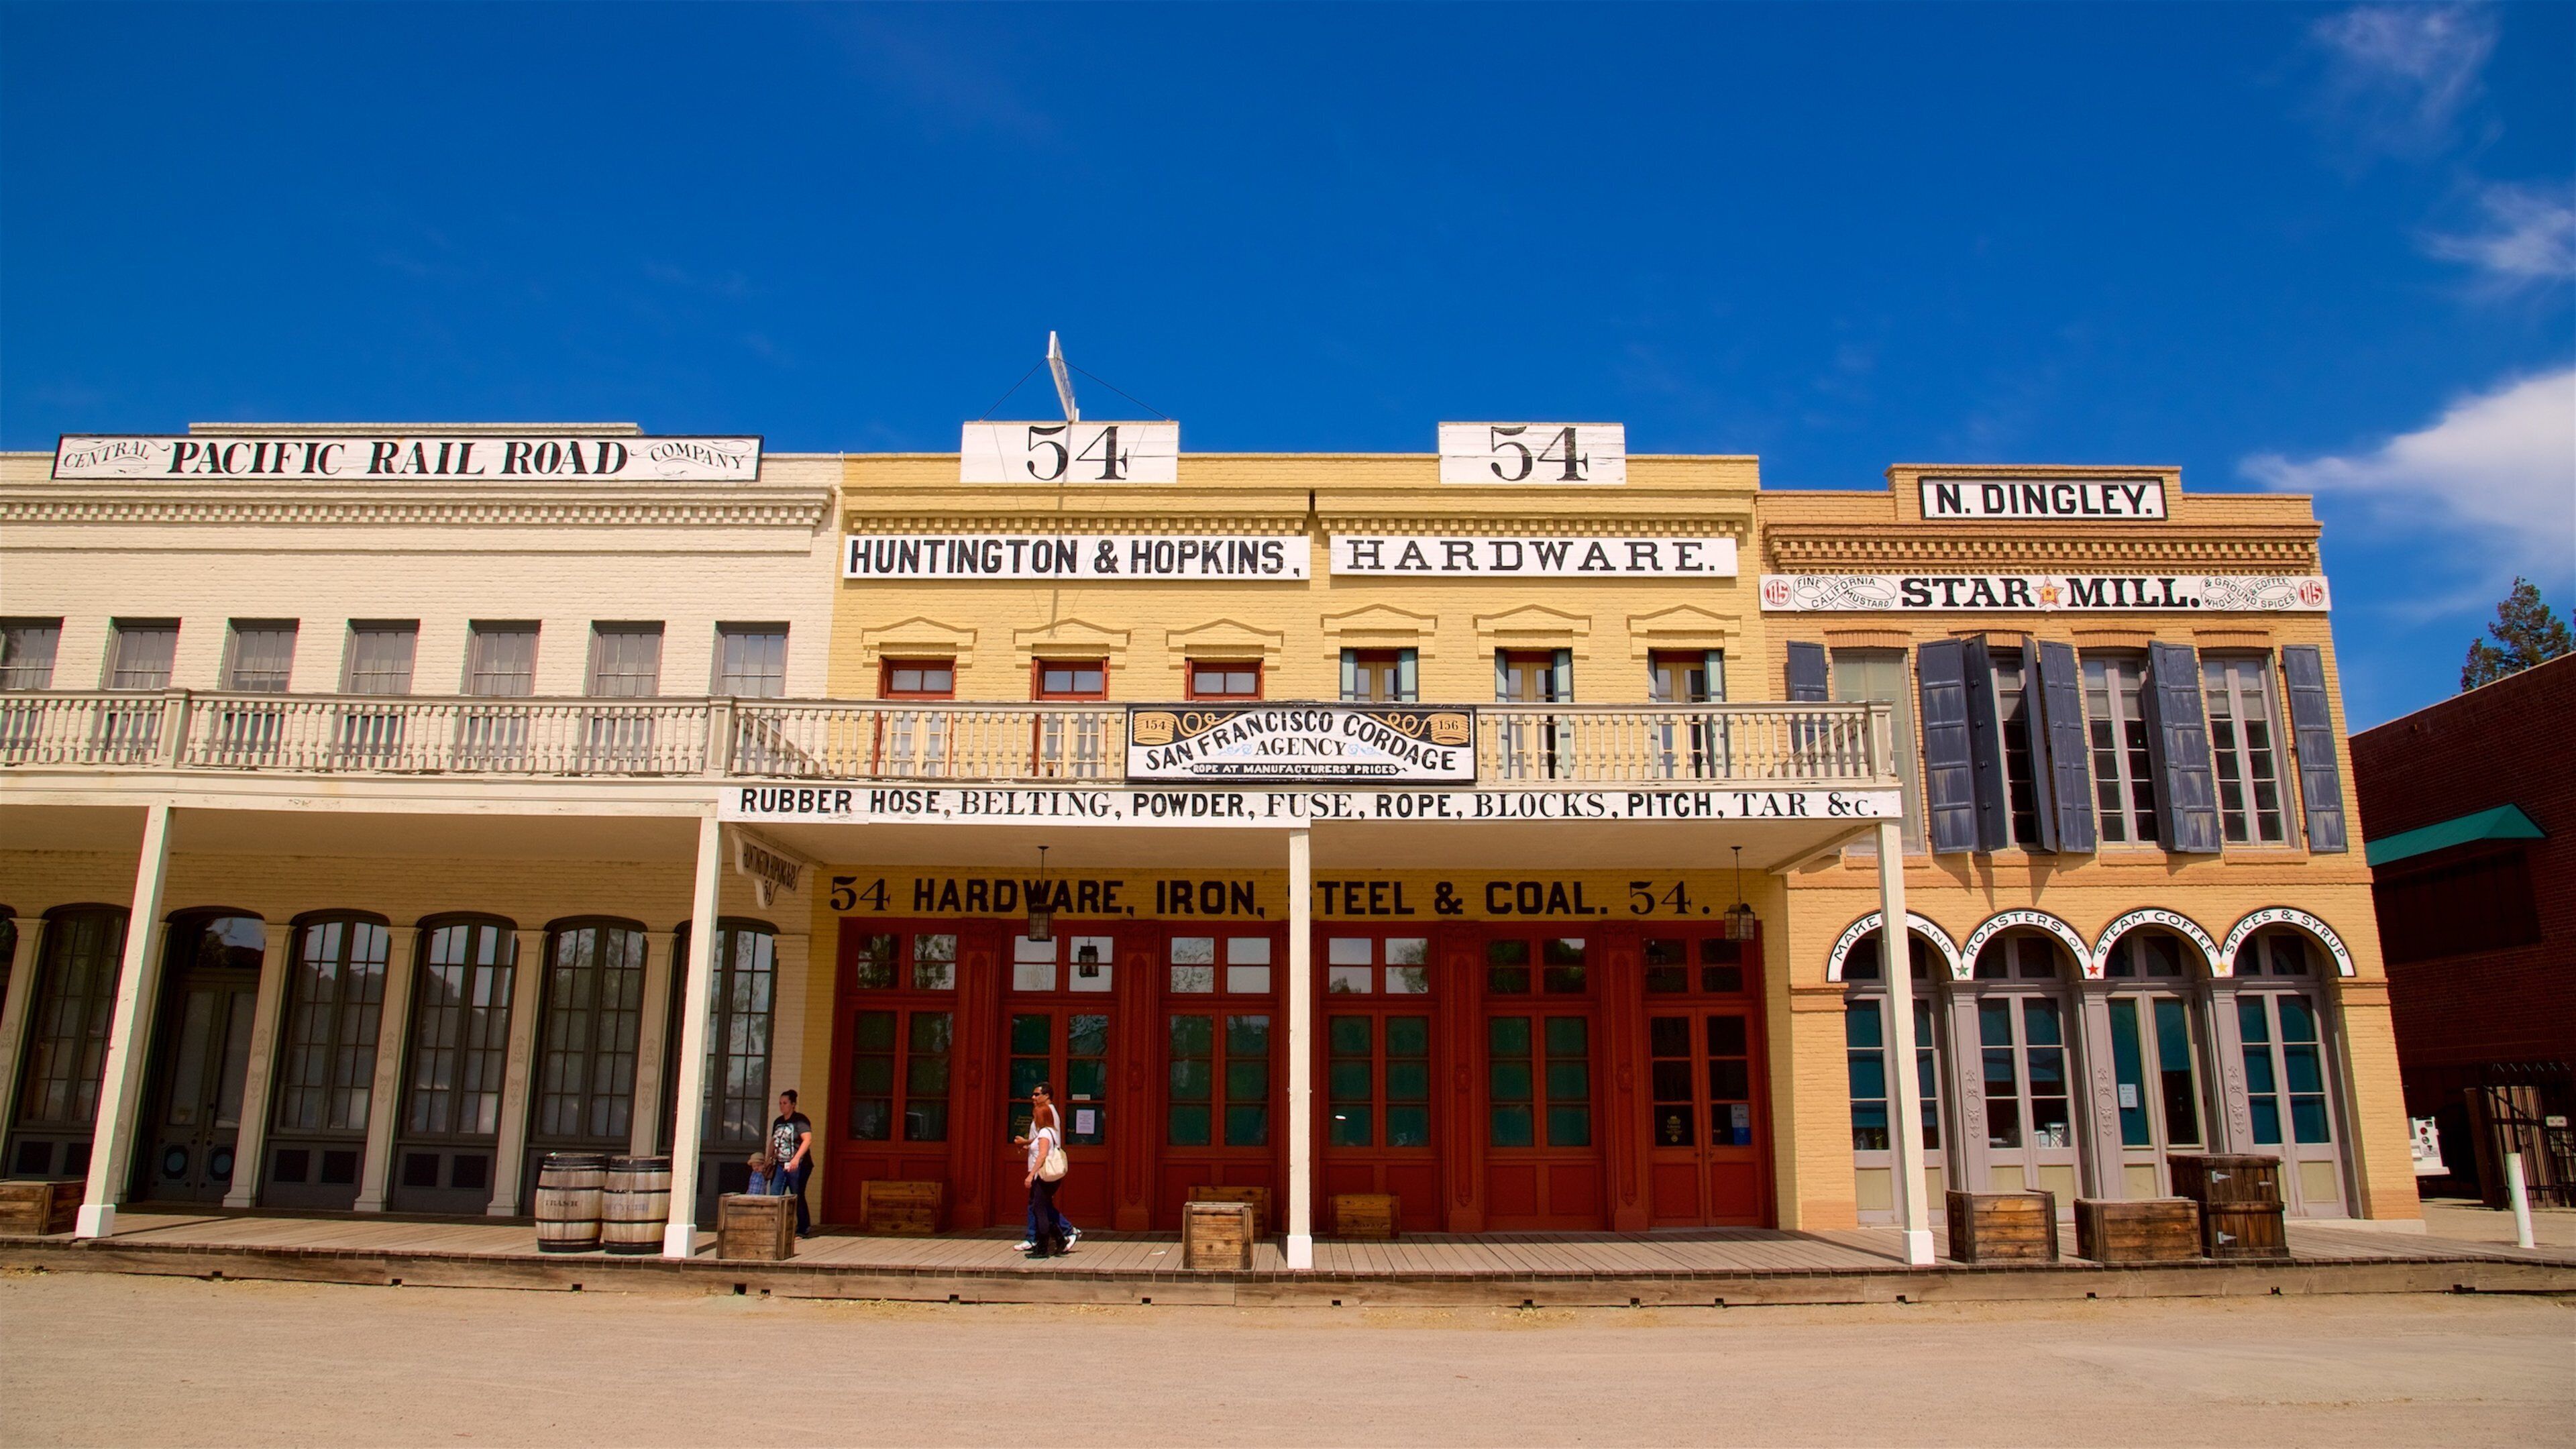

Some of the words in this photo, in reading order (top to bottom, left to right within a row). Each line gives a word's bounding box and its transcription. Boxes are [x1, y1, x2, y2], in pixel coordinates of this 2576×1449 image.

[64, 441, 152, 468] CENTRAL
[167, 442, 345, 474] PACIFIC
[366, 442, 485, 474] RAIL
[500, 441, 628, 474] ROAD
[651, 443, 745, 470] COMPANY
[1027, 426, 1128, 480] 54
[1491, 426, 1589, 481] 54
[1936, 484, 1970, 514] N.
[1982, 484, 2152, 515] DINGLEY.
[851, 539, 1077, 574] HUNTINGTON
[1094, 539, 1119, 574] &
[1131, 540, 1300, 577] HOPKINS,
[1346, 540, 1715, 571] HARDWARE.
[1798, 577, 1821, 589] FINE
[1811, 578, 1876, 608] CALIFORNIA
[1900, 578, 2035, 607] STAR
[2066, 578, 2200, 608] MILL.
[2215, 578, 2257, 605] GROUND
[2255, 578, 2288, 590] COFFEE
[1844, 590, 1889, 607] MUSTARD
[2204, 592, 2235, 608] WHOLE
[2261, 593, 2295, 608] SPICES
[1145, 719, 1167, 730] 154
[1438, 720, 1458, 731] 156
[1146, 743, 1193, 769] SAN
[1197, 710, 1334, 756] FRANCISCO
[1344, 714, 1456, 770] CORDAGE
[1256, 737, 1346, 755] AGENCY
[1193, 765, 1218, 773] ROPE
[1223, 765, 1239, 773] AT
[1244, 764, 1351, 773] MANUFACTURERS'
[1355, 765, 1397, 773] PRICES
[741, 788, 852, 813] RUBBER
[871, 790, 951, 818] HOSE,
[958, 791, 1122, 819] BELTING,
[1133, 794, 1255, 820] POWDER,
[1264, 793, 1366, 820] FUSE,
[1377, 794, 1463, 820] ROPE,
[1472, 792, 1618, 819] BLOCKS,
[1627, 793, 1724, 819] PITCH,
[1733, 792, 1810, 816] TAR
[830, 876, 891, 911] 54
[914, 879, 1134, 918] HARDWARE,
[1156, 880, 1265, 920] IRON,
[1288, 881, 1415, 915] TEEL
[1434, 881, 1464, 915] &
[1485, 880, 1608, 915] COAL.
[1917, 924, 1951, 954] AND
[1966, 912, 2063, 957] ROASTERS
[2068, 936, 2088, 957] OF
[2098, 912, 2145, 956] STEAM
[2155, 912, 2216, 956] COFFEE
[2225, 911, 2272, 955] SPICES
[2281, 910, 2293, 920] &
[2301, 915, 2346, 959] SYRUP
